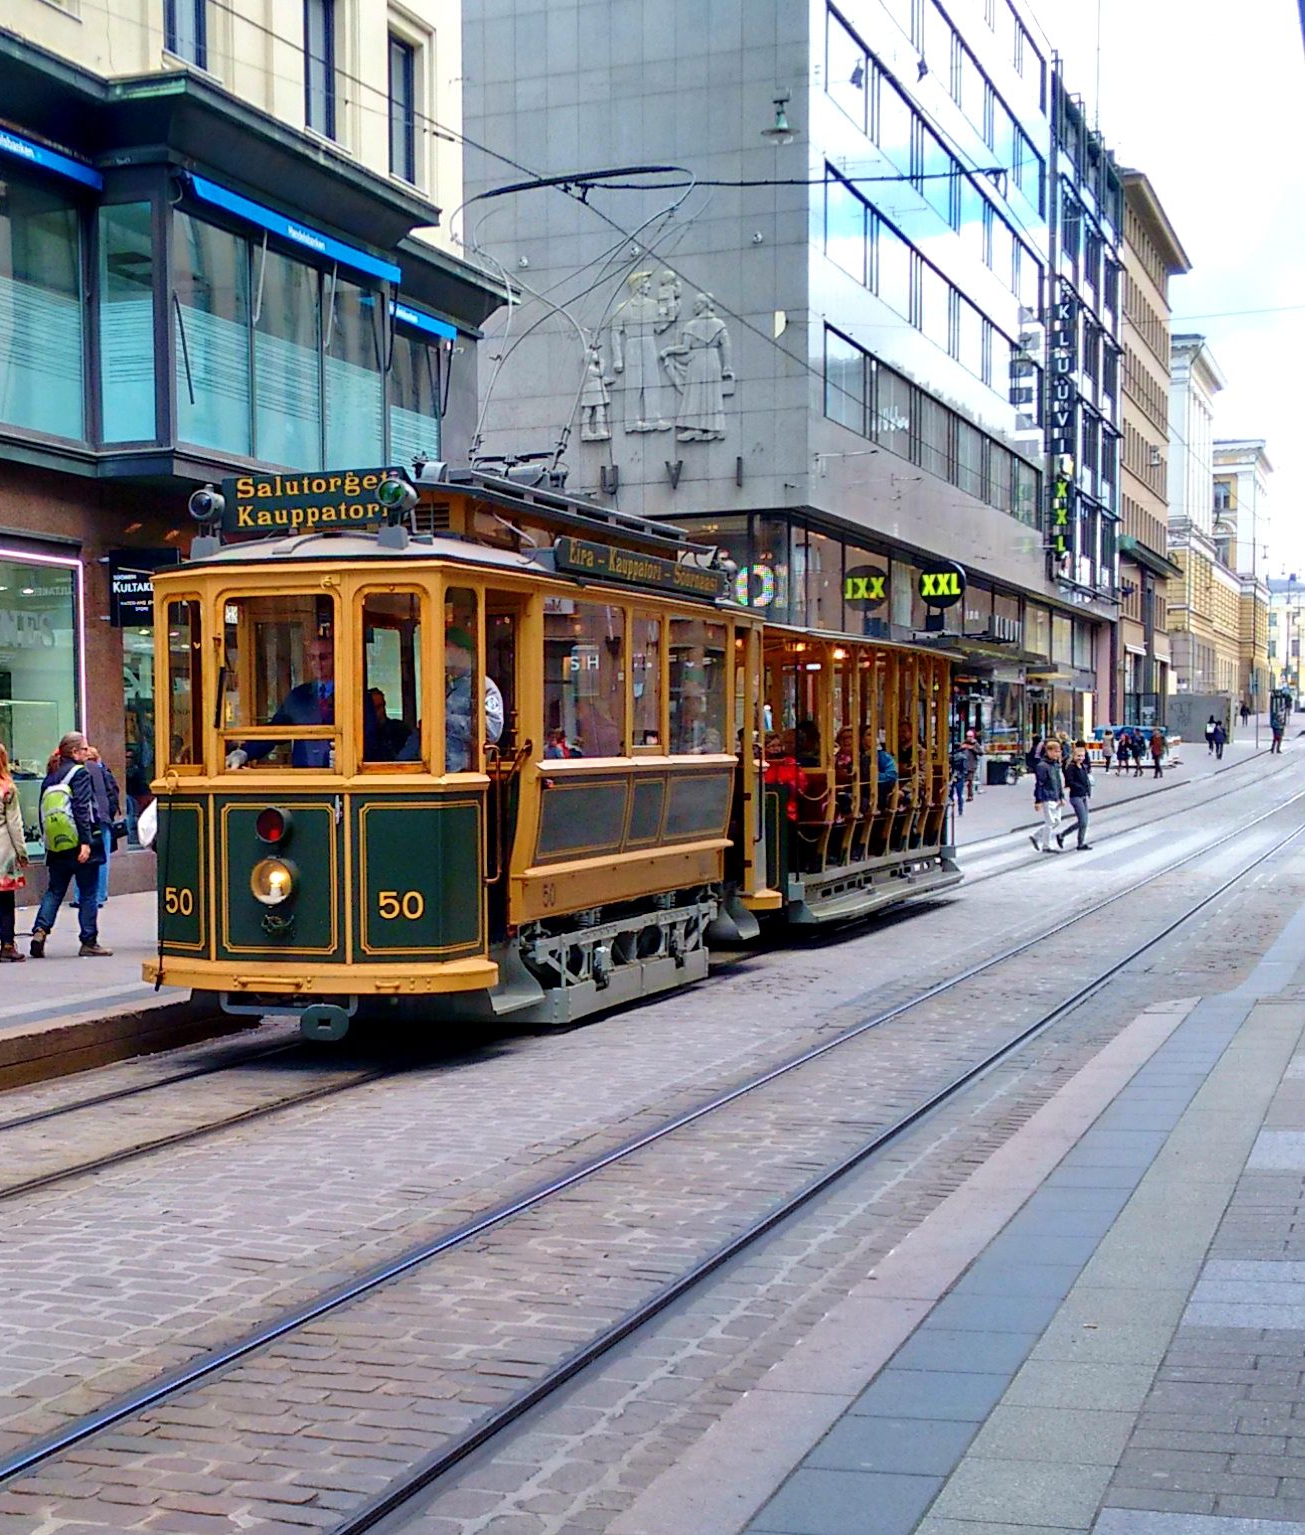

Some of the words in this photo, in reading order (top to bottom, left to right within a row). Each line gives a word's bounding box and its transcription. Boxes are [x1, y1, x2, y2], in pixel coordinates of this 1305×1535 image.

[236, 470, 389, 499] Salutorget
[921, 573, 961, 596] XXL
[165, 887, 193, 916] 50
[378, 891, 425, 919] 50
